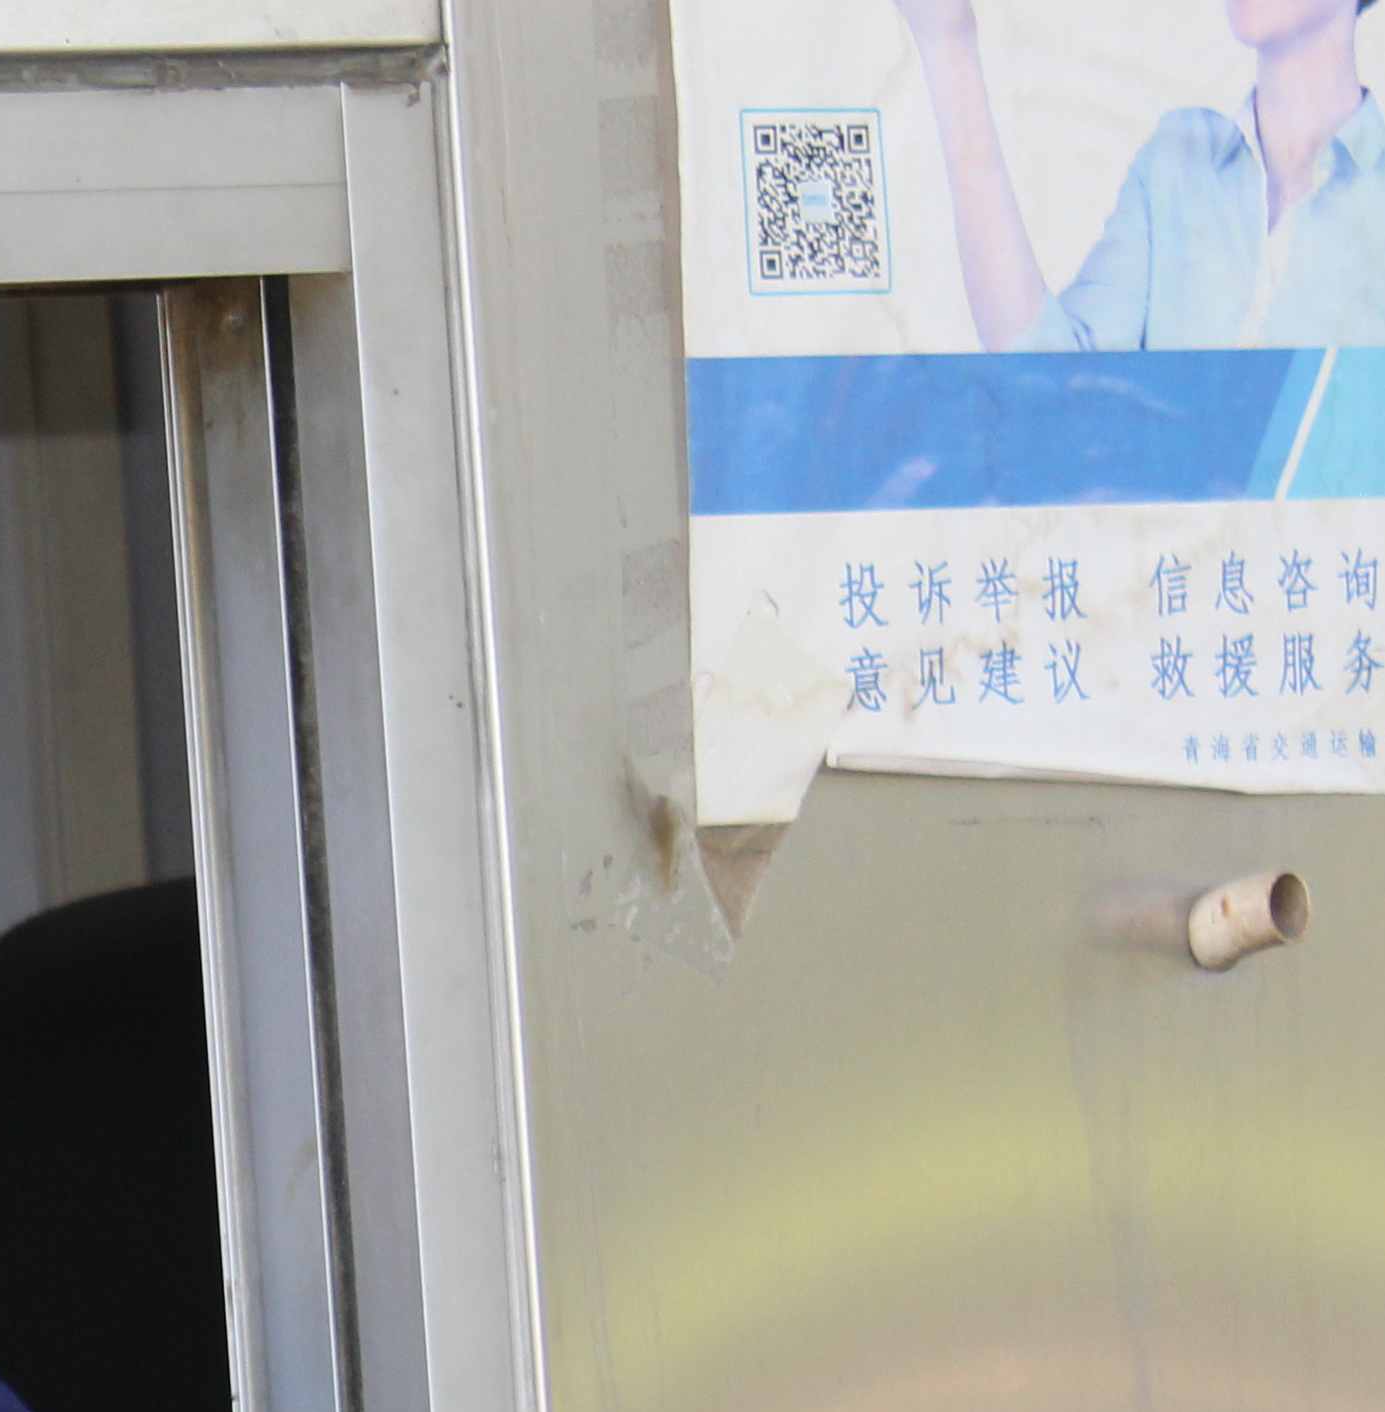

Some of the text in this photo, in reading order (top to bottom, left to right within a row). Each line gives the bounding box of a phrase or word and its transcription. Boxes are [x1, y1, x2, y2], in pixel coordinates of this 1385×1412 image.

[839, 546, 1379, 629] 投诉举报 信息咨询
[845, 628, 1384, 712] 意见建议 救援服务
